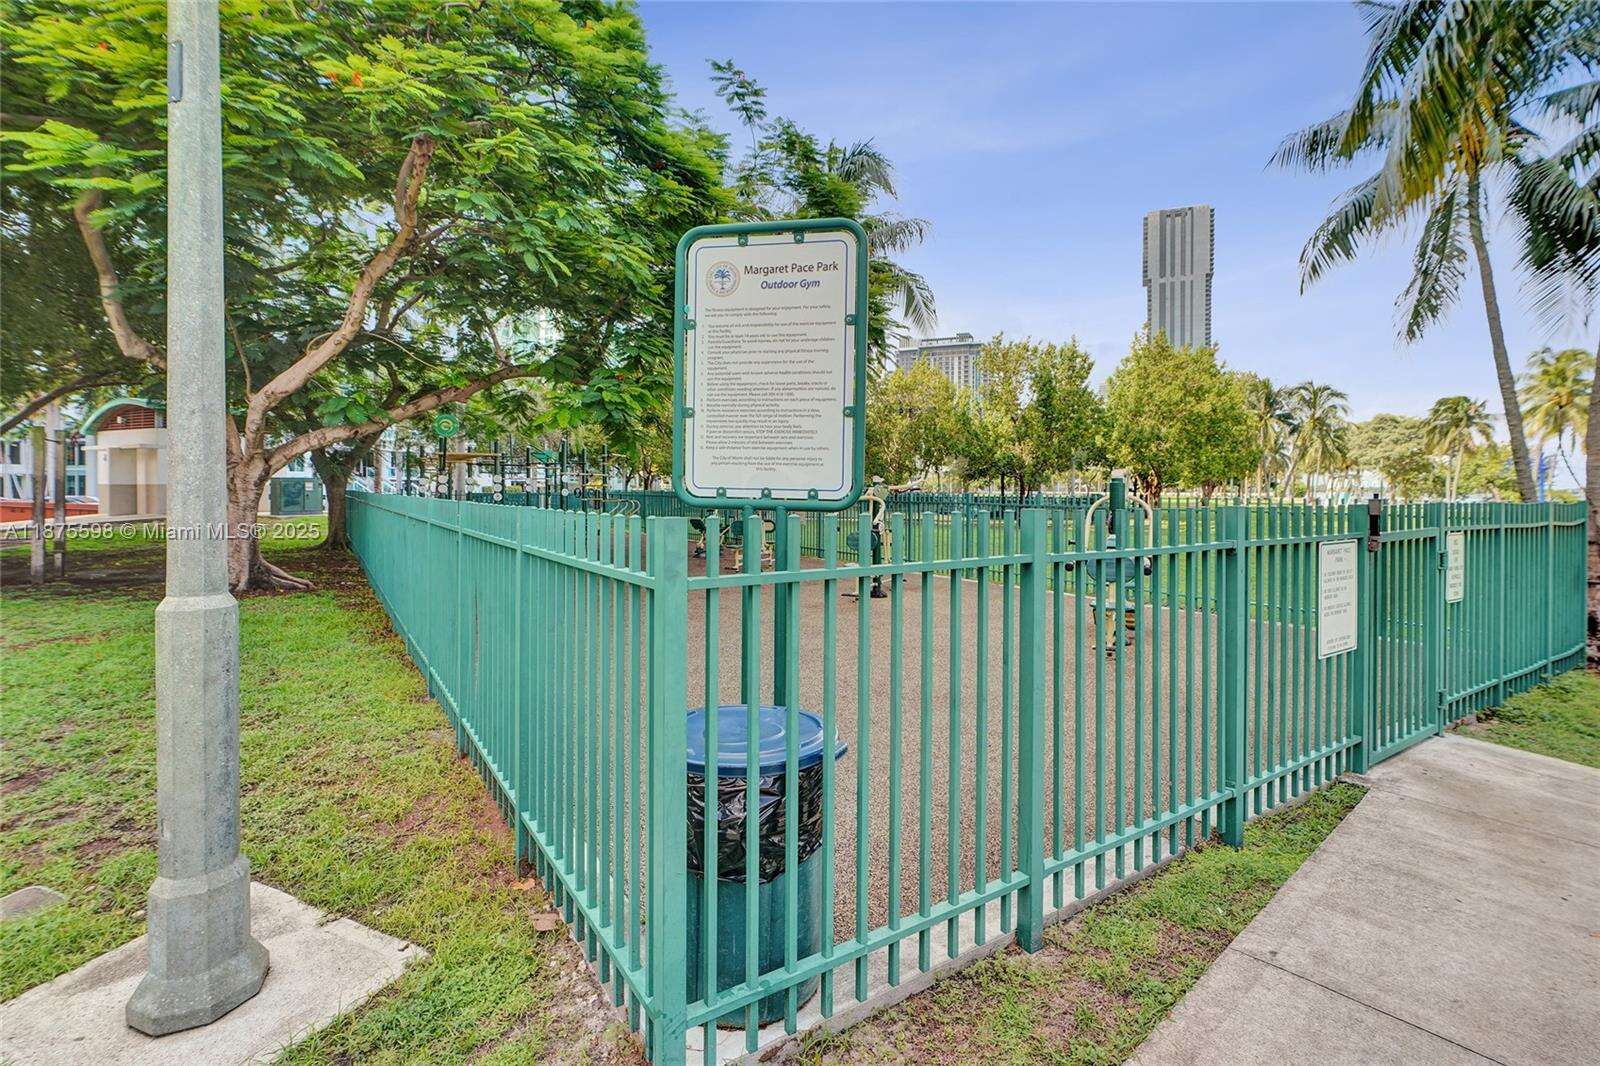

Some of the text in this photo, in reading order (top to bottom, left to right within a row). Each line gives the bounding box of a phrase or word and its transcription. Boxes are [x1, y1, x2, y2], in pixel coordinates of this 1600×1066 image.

[744, 261, 839, 277] Margaret Pace Park
[761, 279, 821, 291] Outdoor Gym
